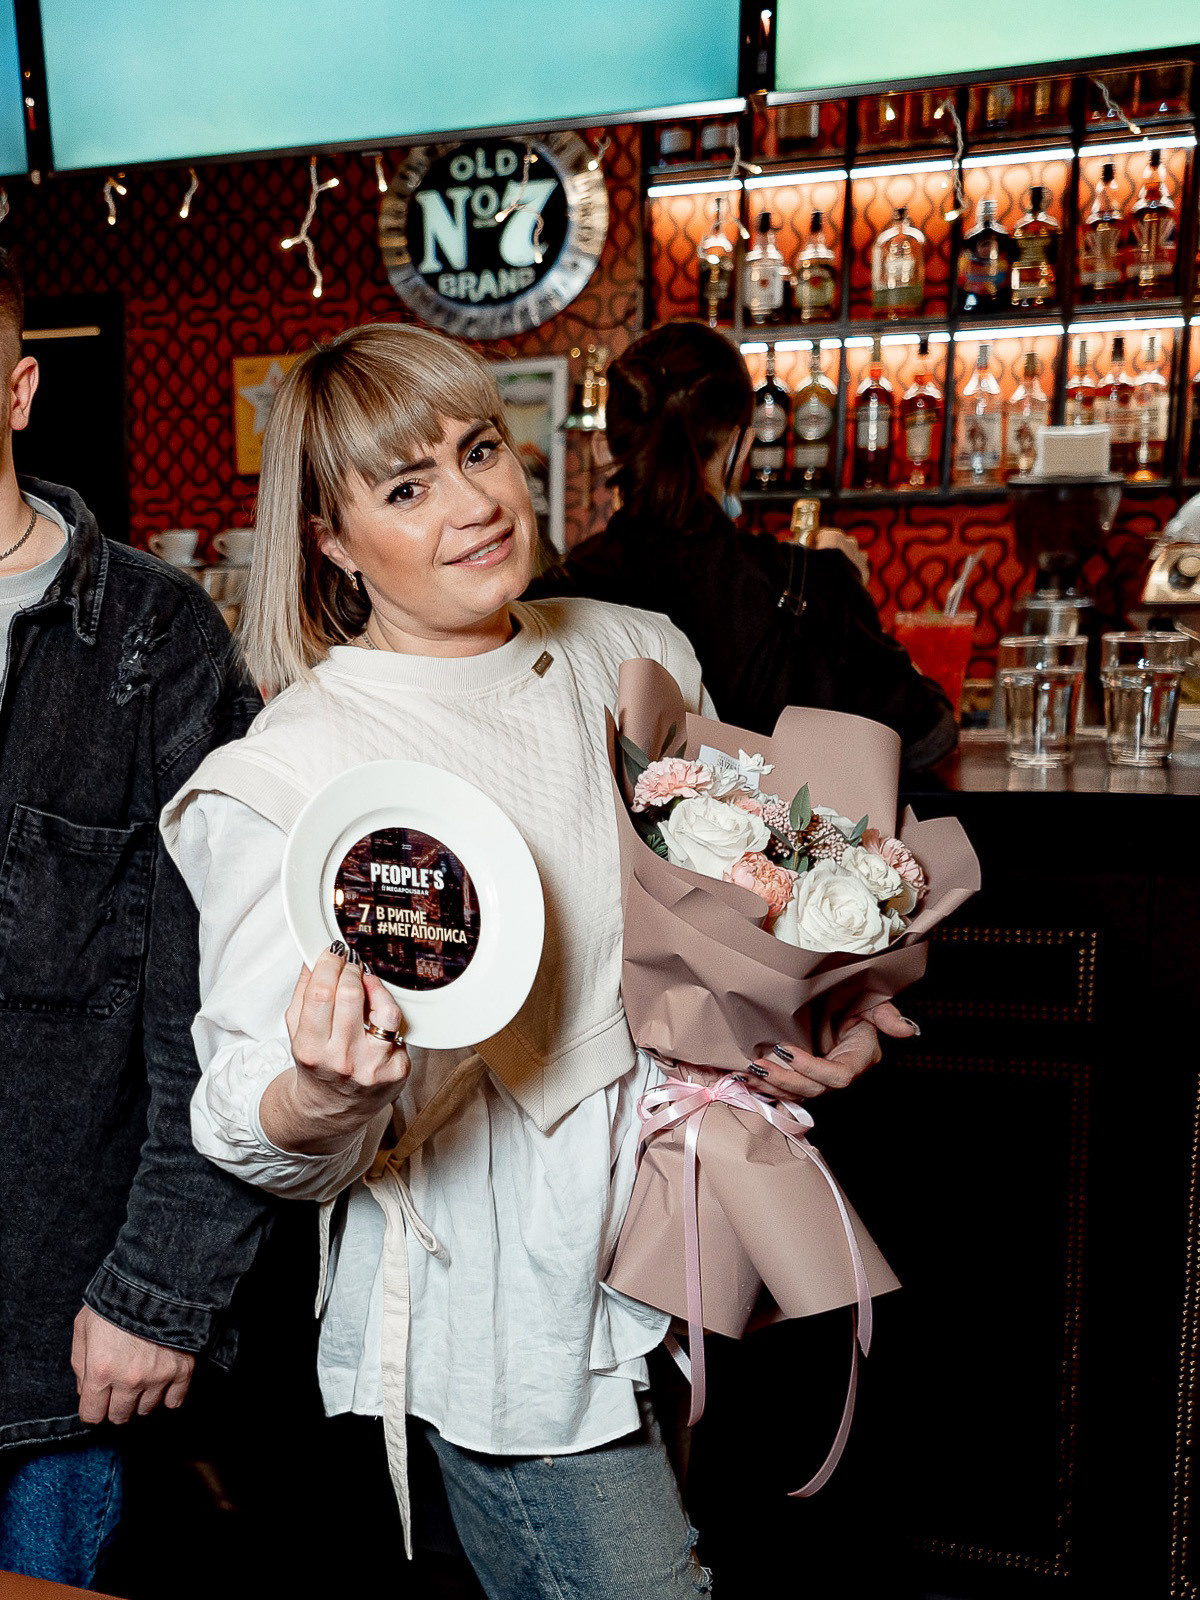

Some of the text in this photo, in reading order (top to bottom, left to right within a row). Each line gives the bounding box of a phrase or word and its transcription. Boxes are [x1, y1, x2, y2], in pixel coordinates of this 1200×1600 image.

[450, 147, 519, 181] OLD
[437, 266, 537, 303] BRAND
[370, 862, 445, 890] PEOPLE'S
[358, 903, 371, 923] 7
[375, 905, 428, 925] В РИТМЕ
[377, 921, 468, 944] #МЕГАПОЛИСА
